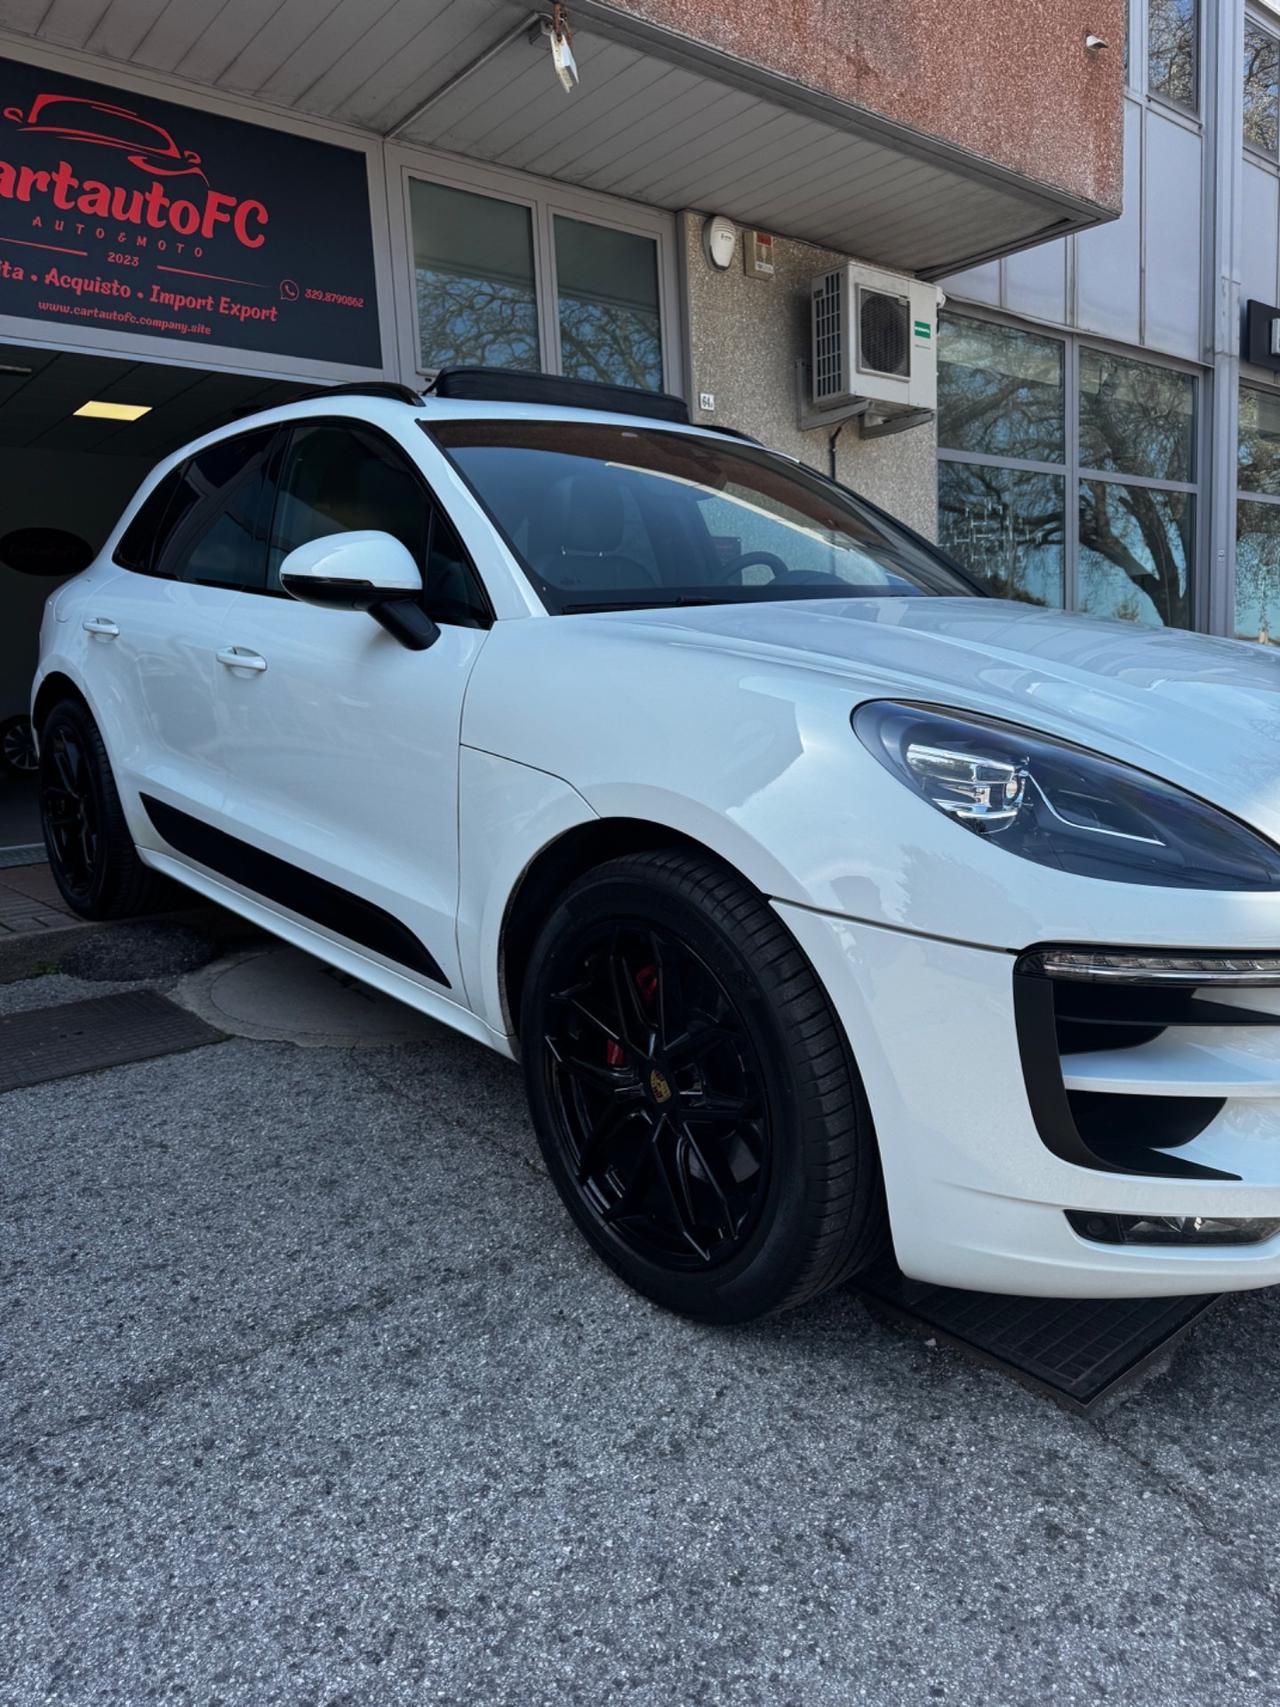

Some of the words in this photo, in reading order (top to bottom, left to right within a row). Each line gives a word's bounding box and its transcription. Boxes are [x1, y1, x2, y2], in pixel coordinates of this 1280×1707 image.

[107, 251, 140, 267] 2023
[44, 267, 132, 298] Acquisto
[150, 285, 214, 311] Import
[218, 296, 278, 322] Export
[37, 301, 212, 335] www.cartautofc.company.site
